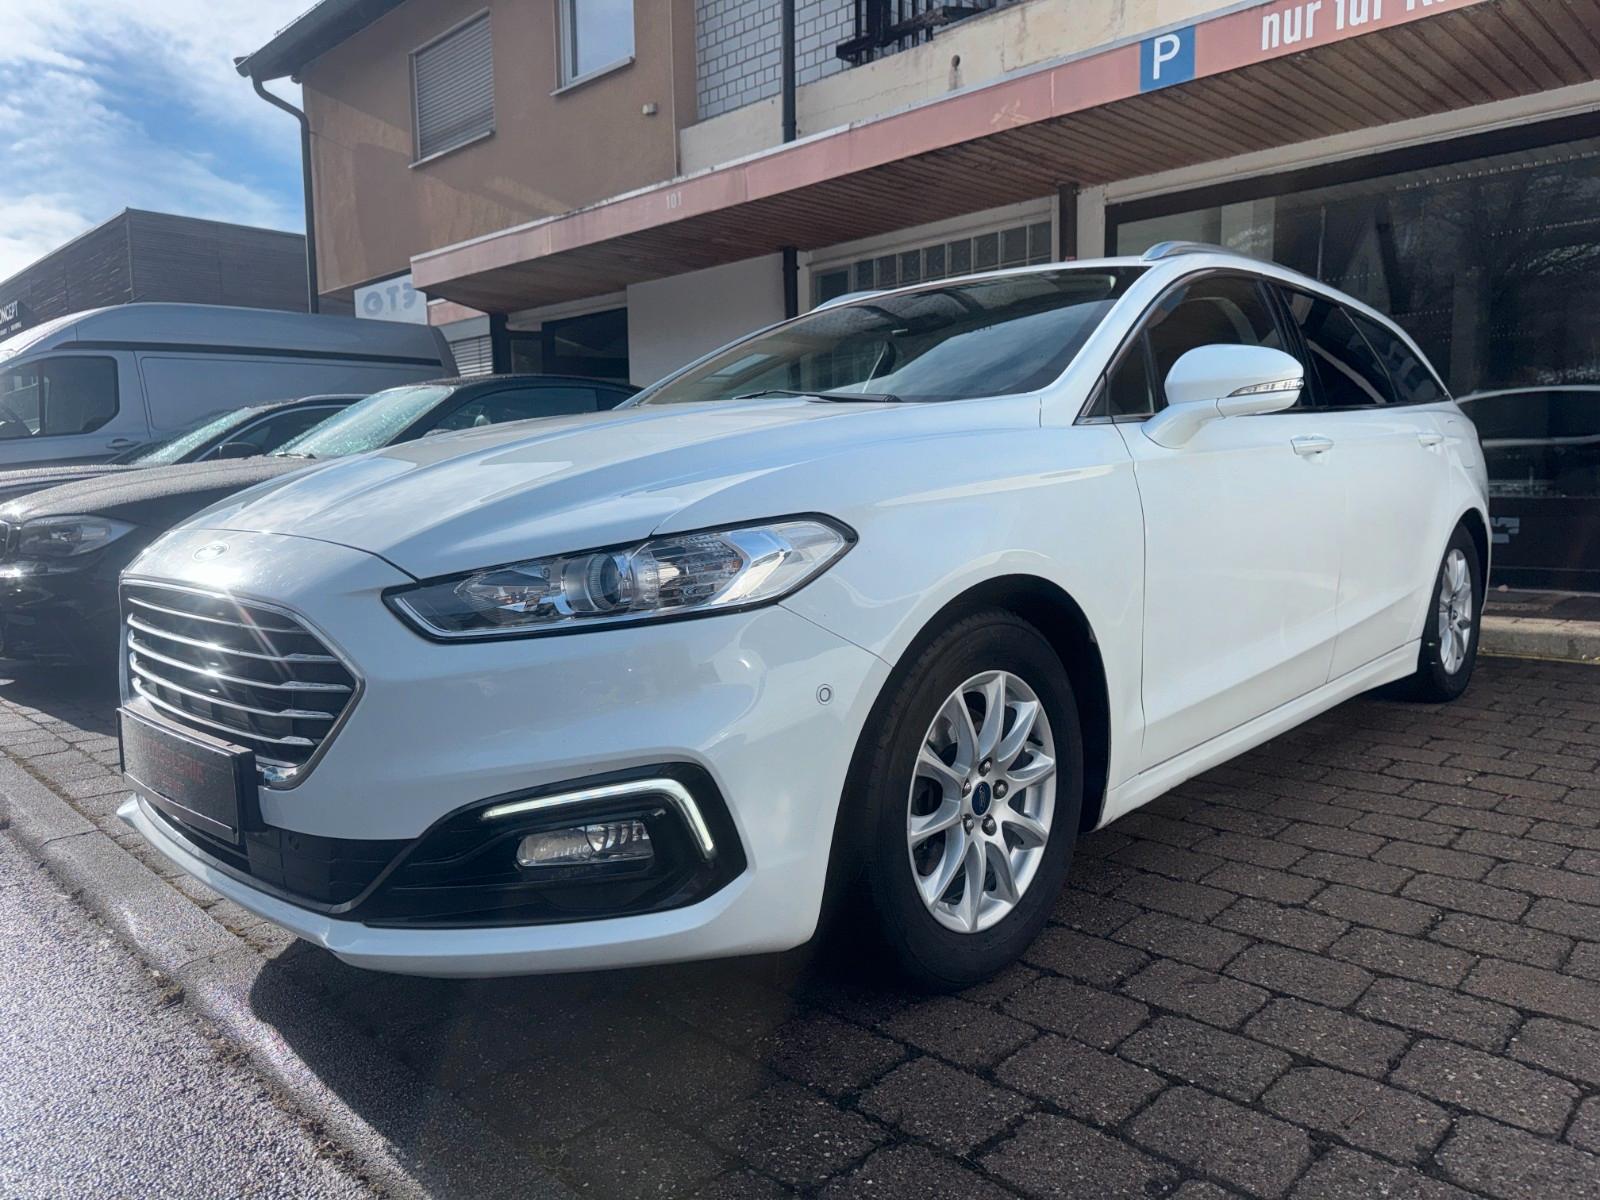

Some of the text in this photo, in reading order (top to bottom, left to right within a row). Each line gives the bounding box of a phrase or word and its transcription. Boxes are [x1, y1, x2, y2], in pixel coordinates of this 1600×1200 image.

[1153, 33, 1181, 80] P
[1261, 0, 1321, 50] nur
[666, 191, 682, 209] 101
